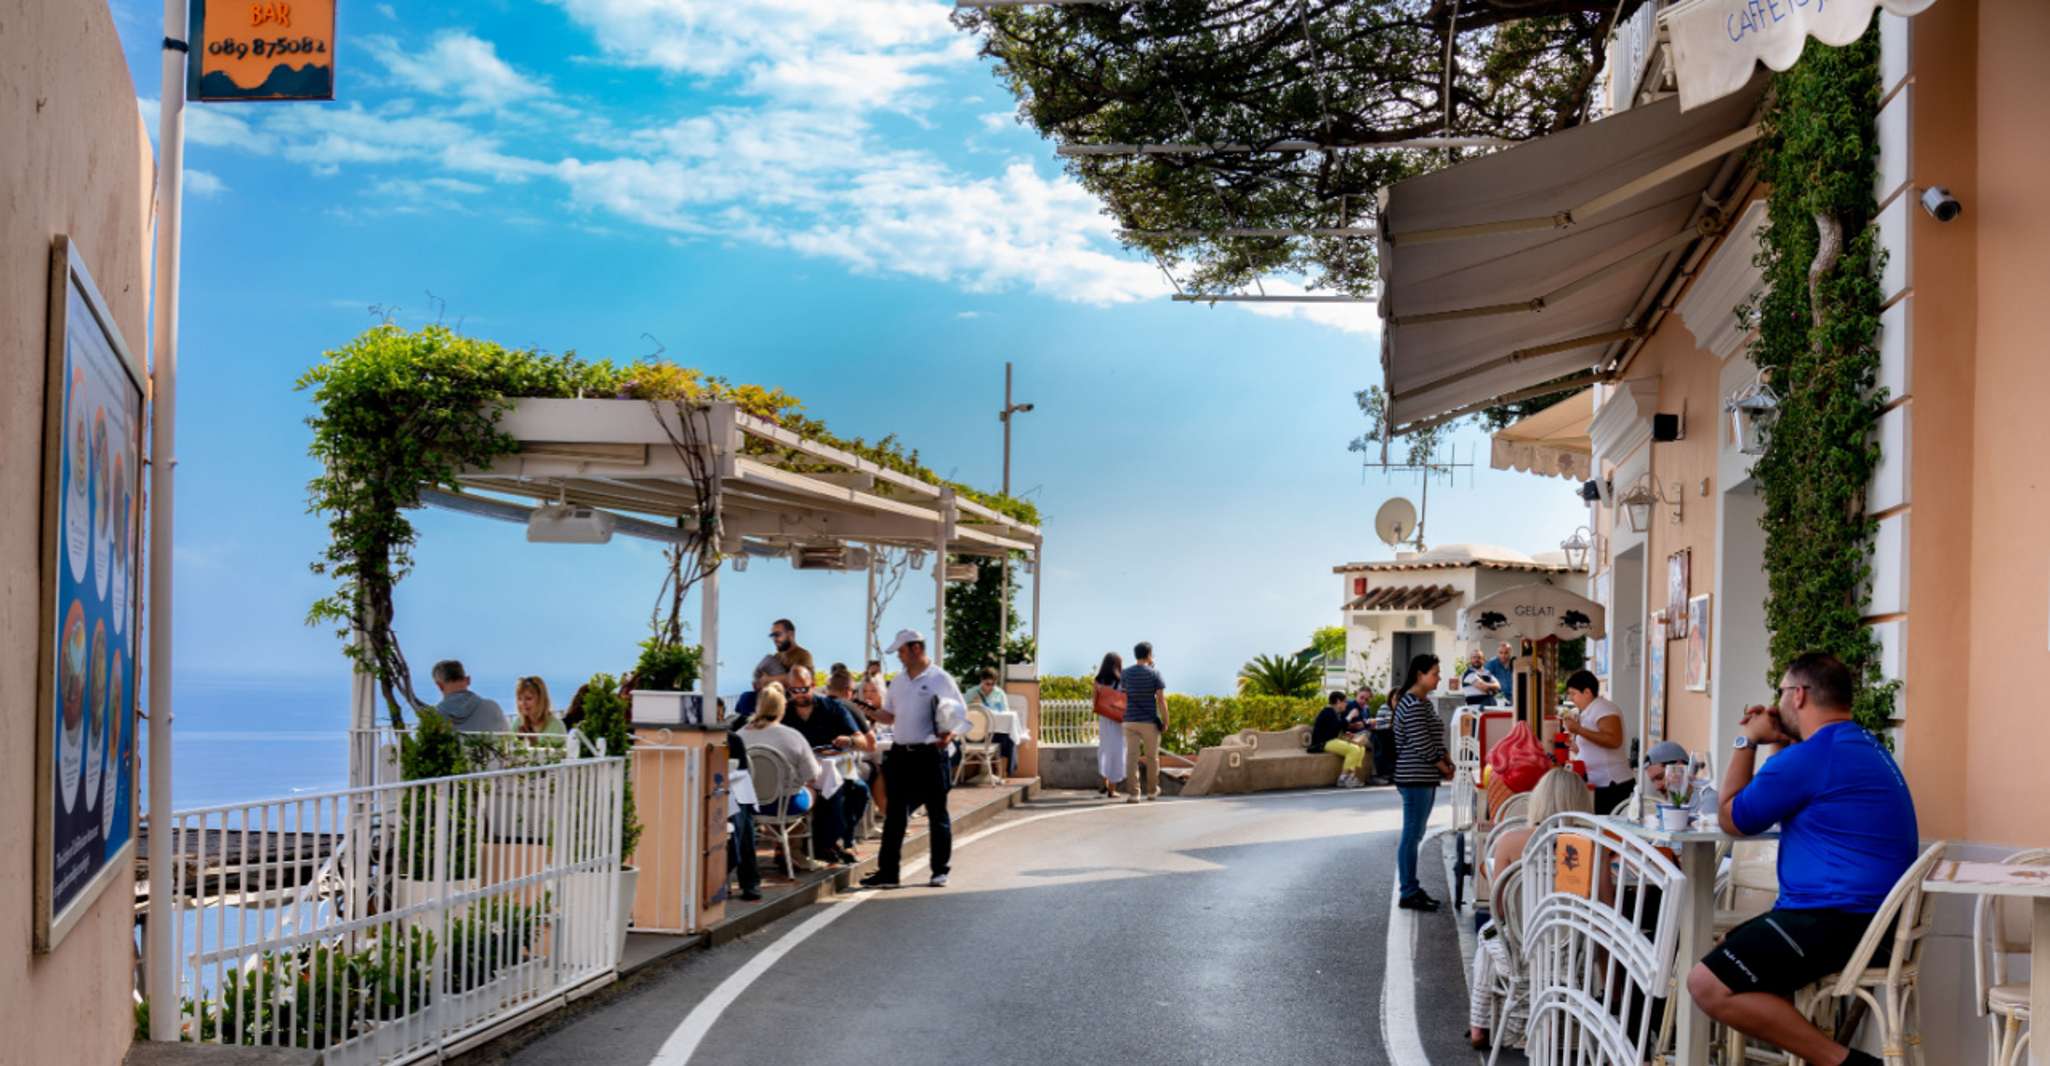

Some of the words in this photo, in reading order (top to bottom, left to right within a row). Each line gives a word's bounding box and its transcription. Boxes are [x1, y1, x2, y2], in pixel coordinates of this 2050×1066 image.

[251, 3, 290, 27] BAR
[208, 38, 248, 60] 089
[1514, 604, 1555, 617] GELATI
